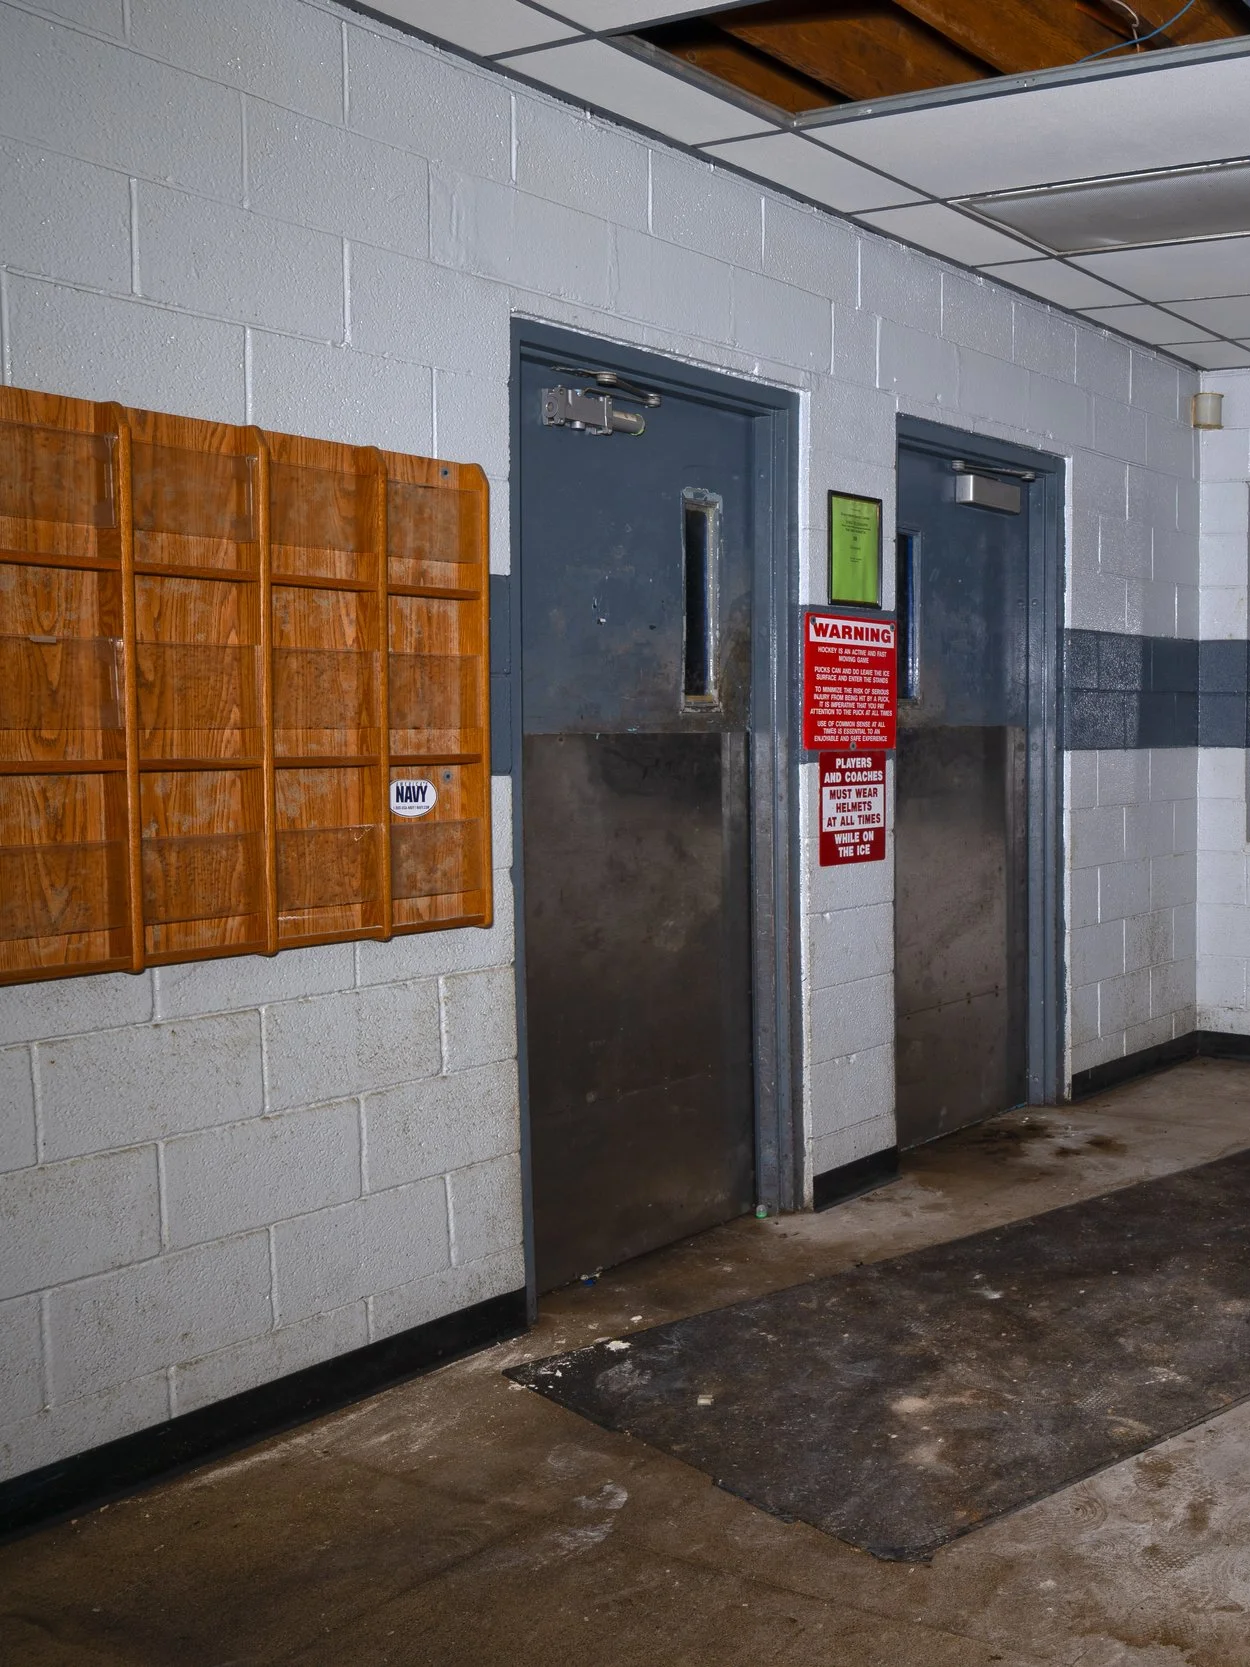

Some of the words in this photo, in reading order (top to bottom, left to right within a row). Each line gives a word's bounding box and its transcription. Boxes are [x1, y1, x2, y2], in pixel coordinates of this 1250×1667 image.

[813, 623, 891, 643] WARNING
[836, 757, 872, 769] PLAYERS
[824, 773, 842, 783] AND
[845, 771, 883, 782] COACHES
[396, 786, 427, 802] NAVY
[829, 789, 852, 800] MUST
[855, 788, 878, 798] WEAR
[836, 801, 872, 813] HELMETS
[827, 817, 837, 827] AT
[840, 815, 854, 826] ALL
[858, 814, 880, 825] TIMES
[835, 833, 859, 844] WHILE
[863, 831, 874, 841] ON
[838, 846, 854, 857] THE
[857, 844, 870, 855] ICE
